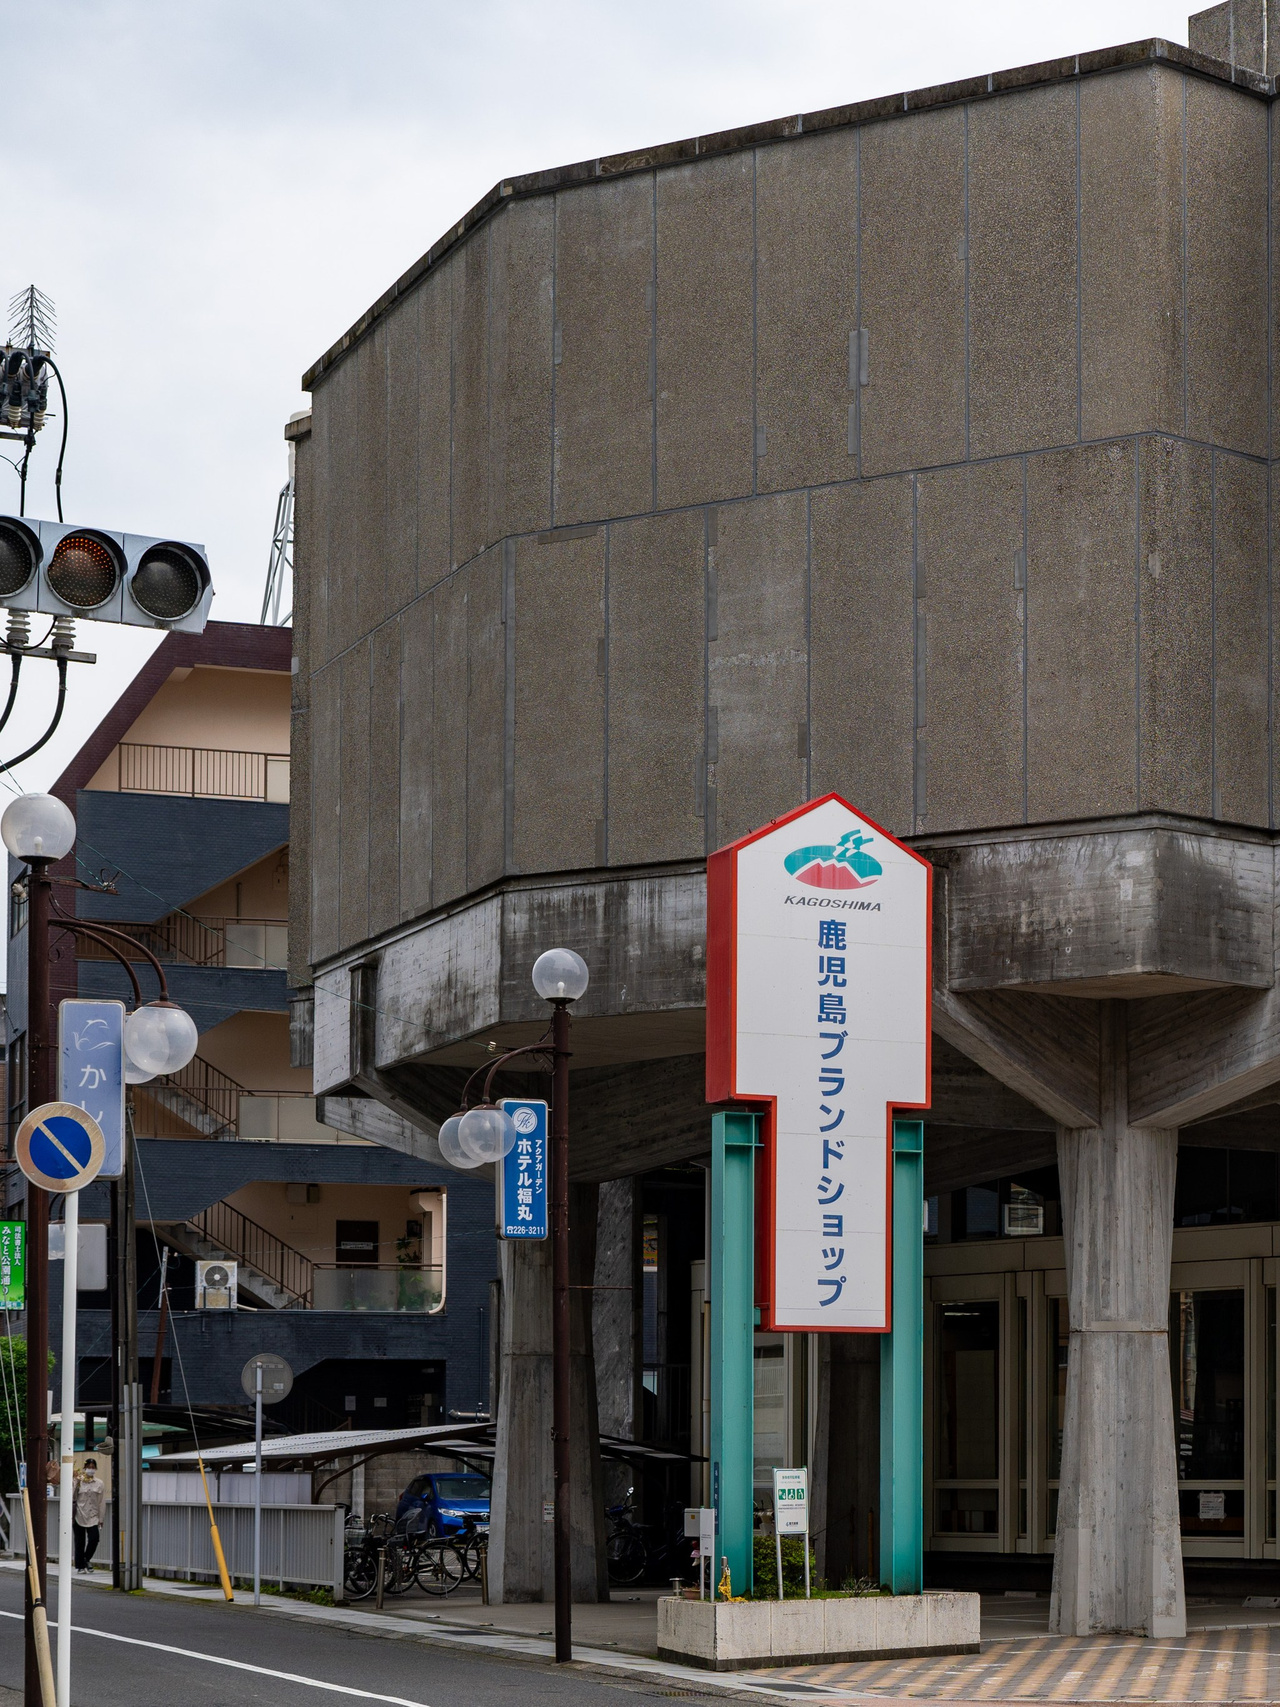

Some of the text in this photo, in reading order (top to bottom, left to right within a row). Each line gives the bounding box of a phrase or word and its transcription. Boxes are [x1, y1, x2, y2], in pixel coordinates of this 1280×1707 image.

[784, 894, 882, 912] KAGOSHIMA
[817, 918, 847, 1308] 鹿児島ブランドショップ
[517, 1138, 533, 1221] ホテル福丸
[535, 1139, 543, 1194] アクアガーデン
[513, 1226, 544, 1235] 226-3211
